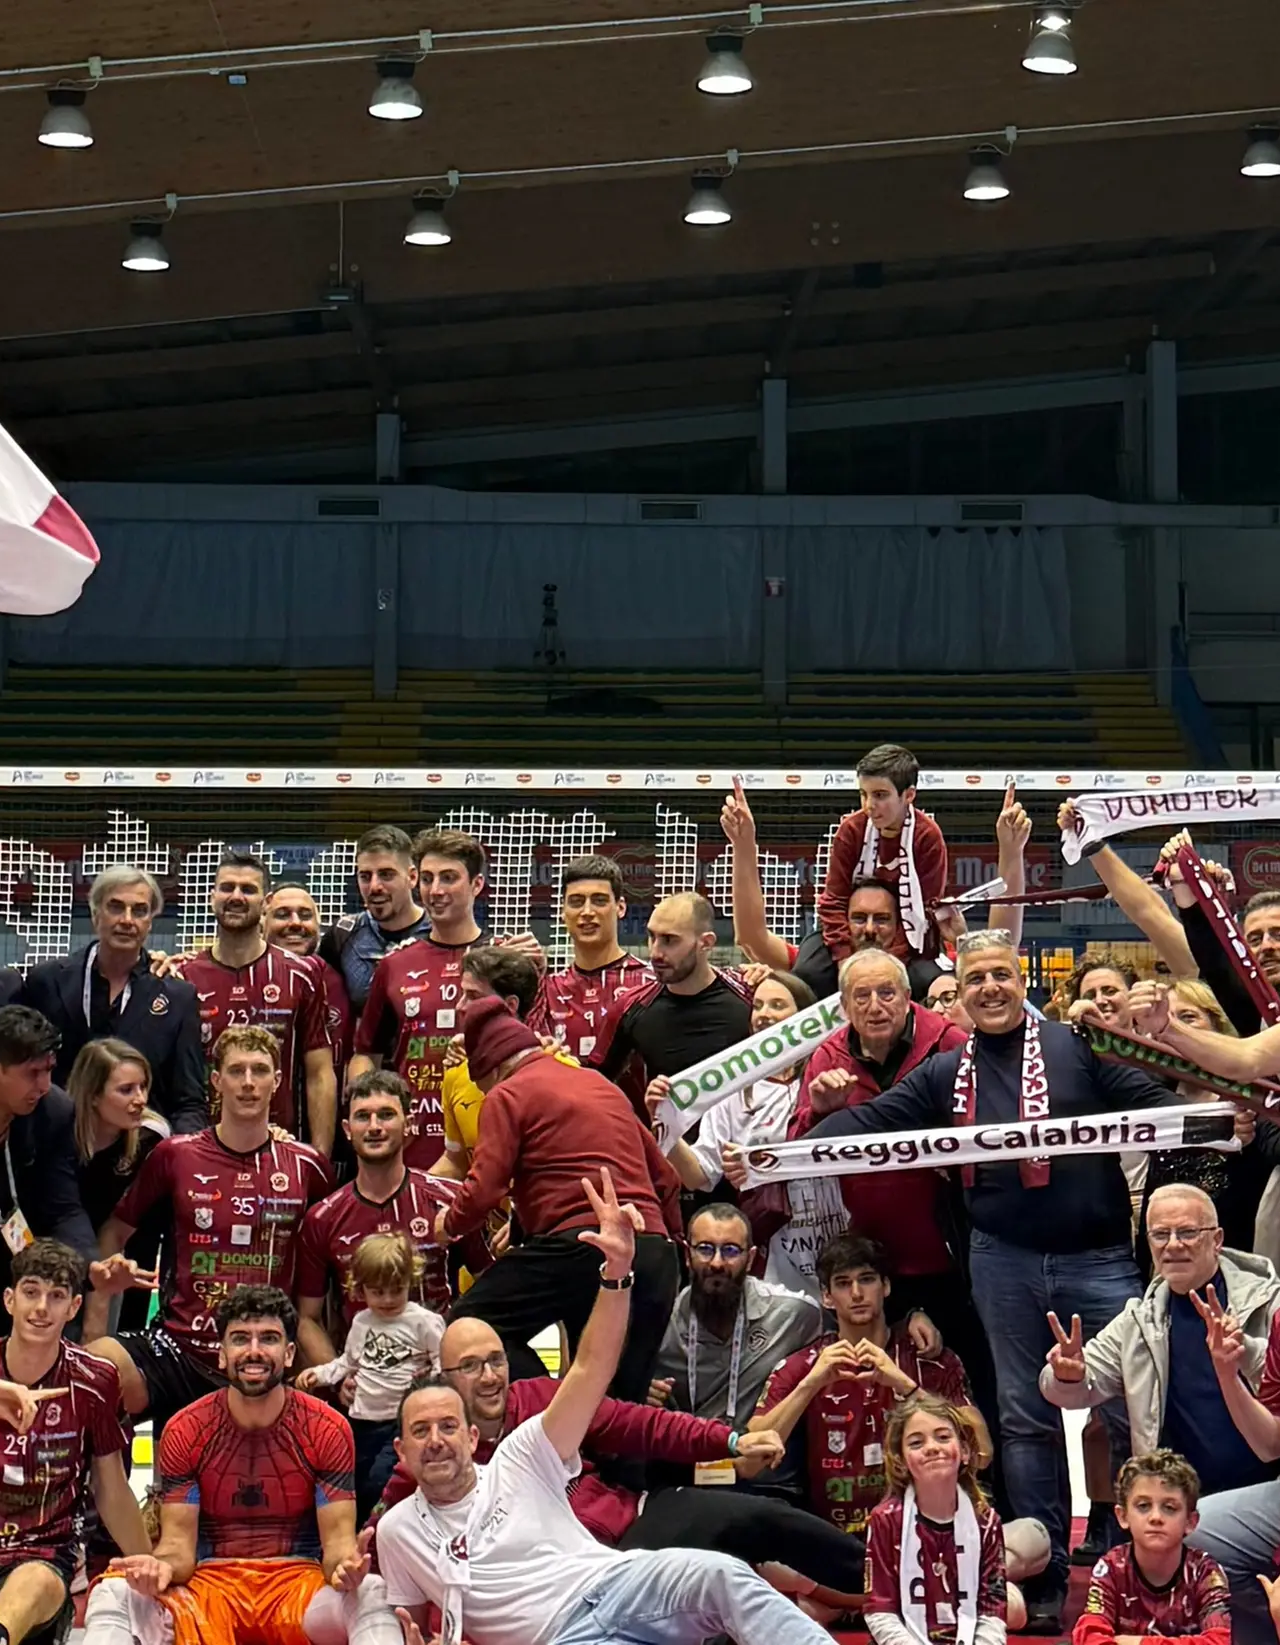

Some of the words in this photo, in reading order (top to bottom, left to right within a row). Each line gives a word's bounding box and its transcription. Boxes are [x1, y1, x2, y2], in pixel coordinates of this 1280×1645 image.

[955, 857, 1046, 887] Moe
[439, 984, 457, 1001] 10
[226, 1009, 250, 1027] 23
[583, 1010, 595, 1028] 9
[669, 1003, 845, 1111] Domotek
[811, 1134, 960, 1166] Reggio
[973, 1116, 1157, 1152] Calabria
[230, 1196, 255, 1216] 35
[3, 1434, 28, 1455] 29
